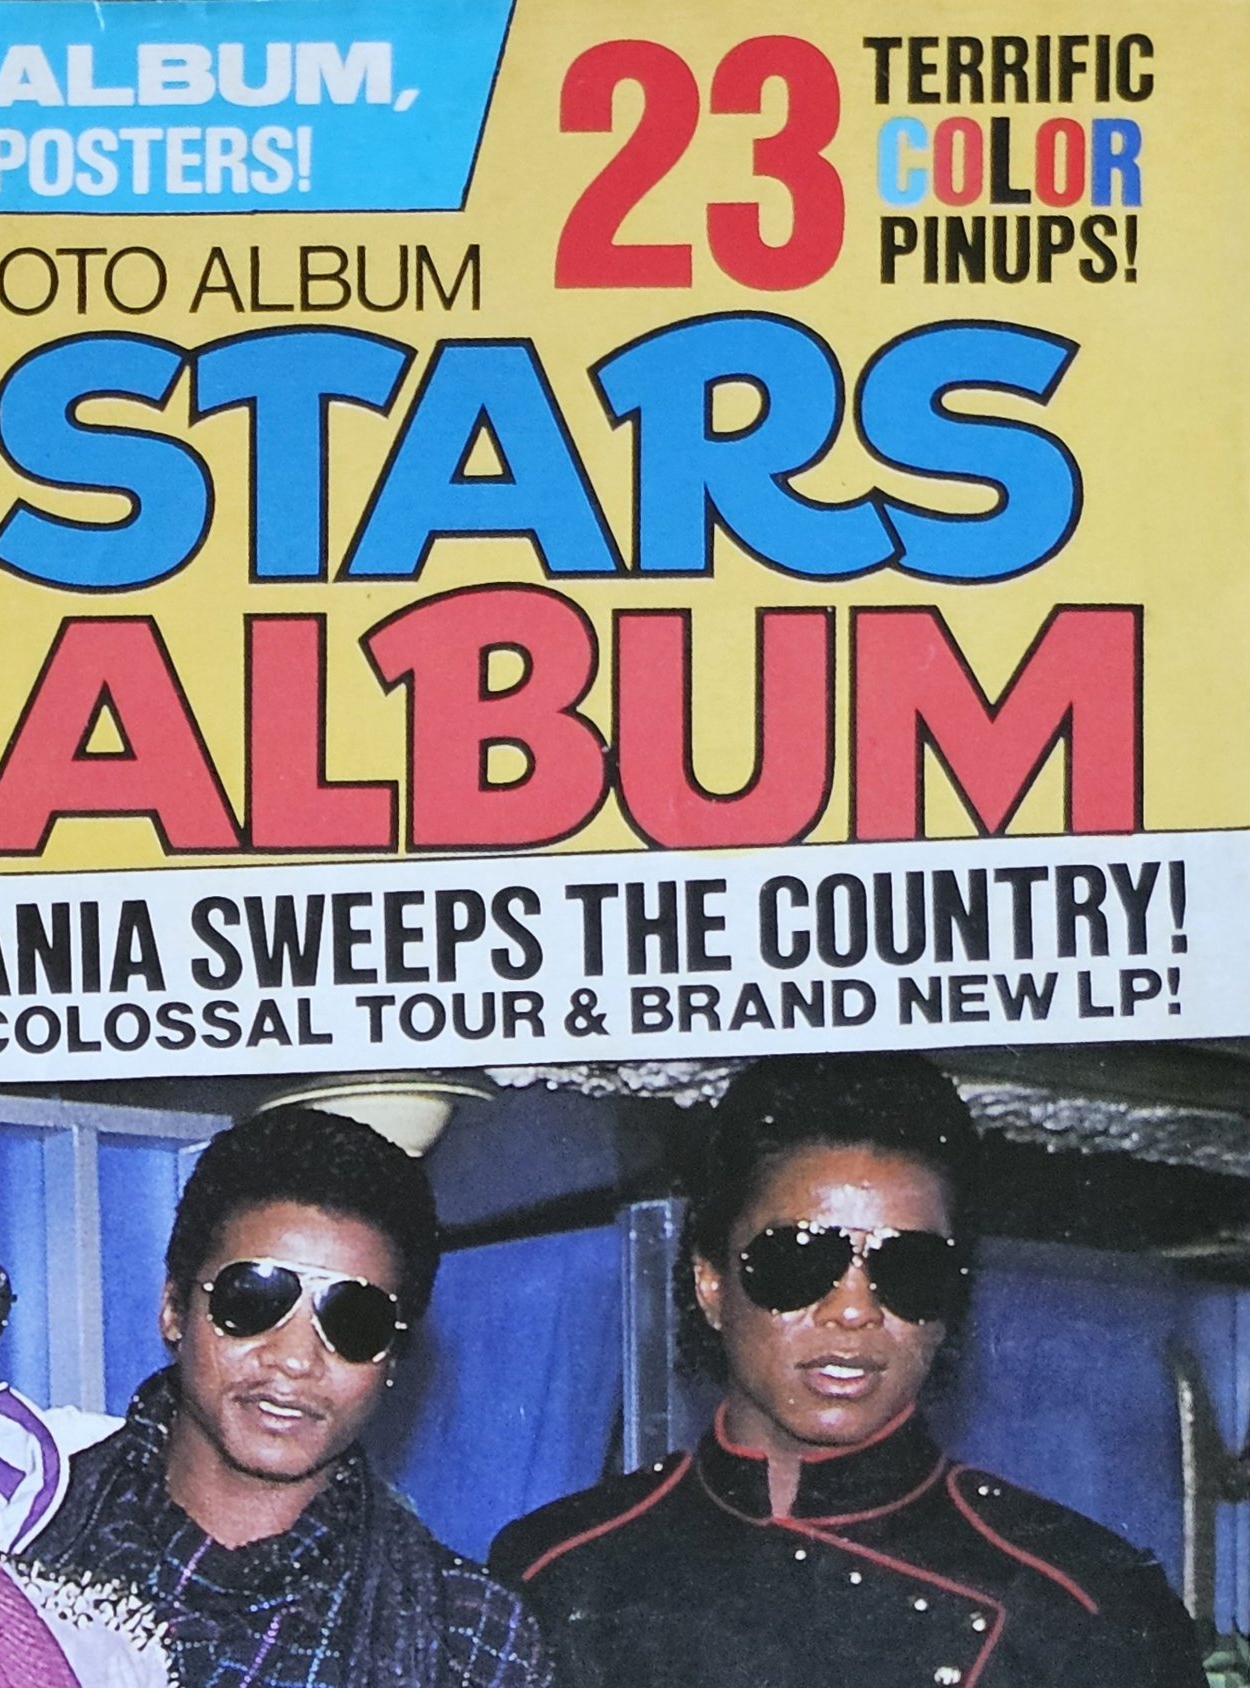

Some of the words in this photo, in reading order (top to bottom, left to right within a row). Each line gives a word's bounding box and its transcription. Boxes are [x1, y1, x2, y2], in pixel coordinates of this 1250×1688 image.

[864, 33, 1154, 106] TERRIFIC
[555, 34, 845, 291] 23
[877, 117, 1143, 209] COLOR
[190, 243, 481, 313] ALBUM
[880, 214, 1138, 286] PINUPS!
[191, 884, 543, 989] SWEEPS
[566, 879, 732, 977] THE
[759, 860, 1189, 970] COUNTRY!
[356, 991, 545, 1044] TOUR
[565, 988, 609, 1037] &
[631, 978, 876, 1034] BRAND
[900, 972, 1057, 1025] NEW
[1078, 966, 1182, 1018] LP!
